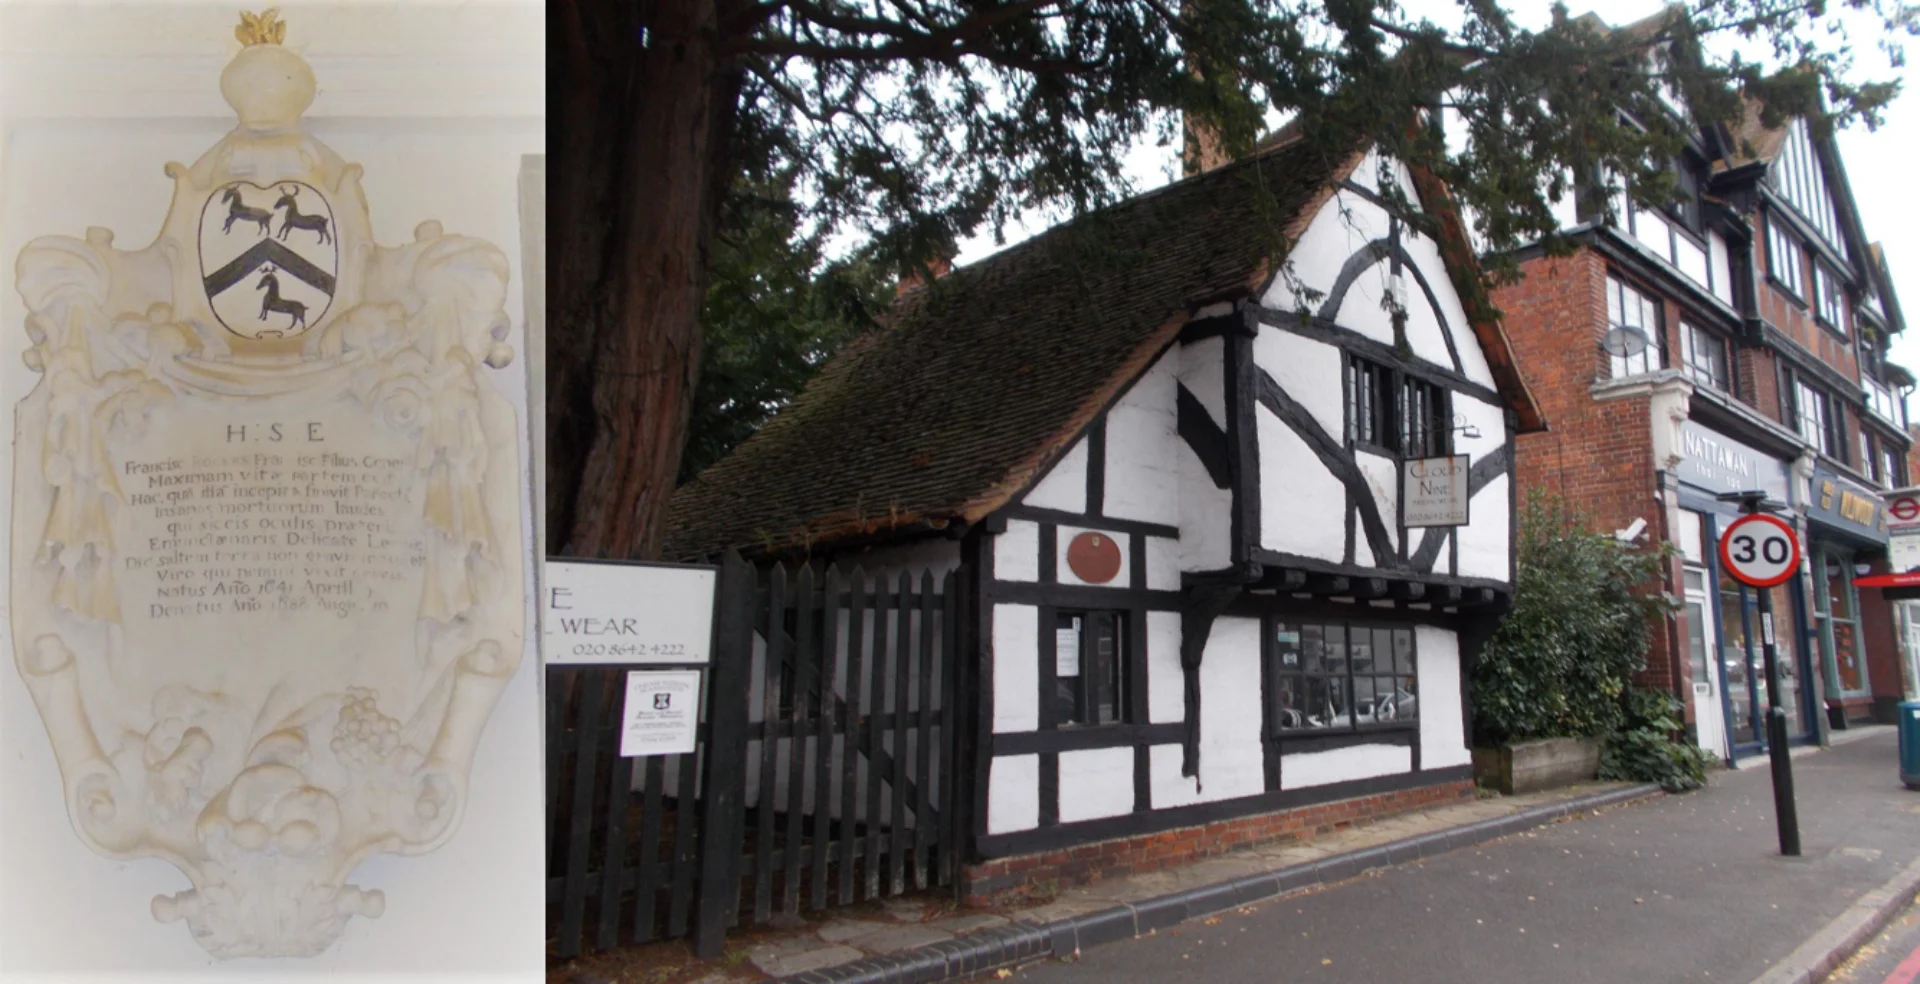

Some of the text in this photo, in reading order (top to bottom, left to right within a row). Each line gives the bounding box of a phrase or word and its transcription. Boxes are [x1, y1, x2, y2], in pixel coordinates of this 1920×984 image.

[1685, 429, 1749, 478] NATTAWAN
[1732, 535, 1789, 565] 30
[560, 617, 638, 636] WEAR
[572, 644, 606, 656] 020
[608, 644, 647, 656] 8642
